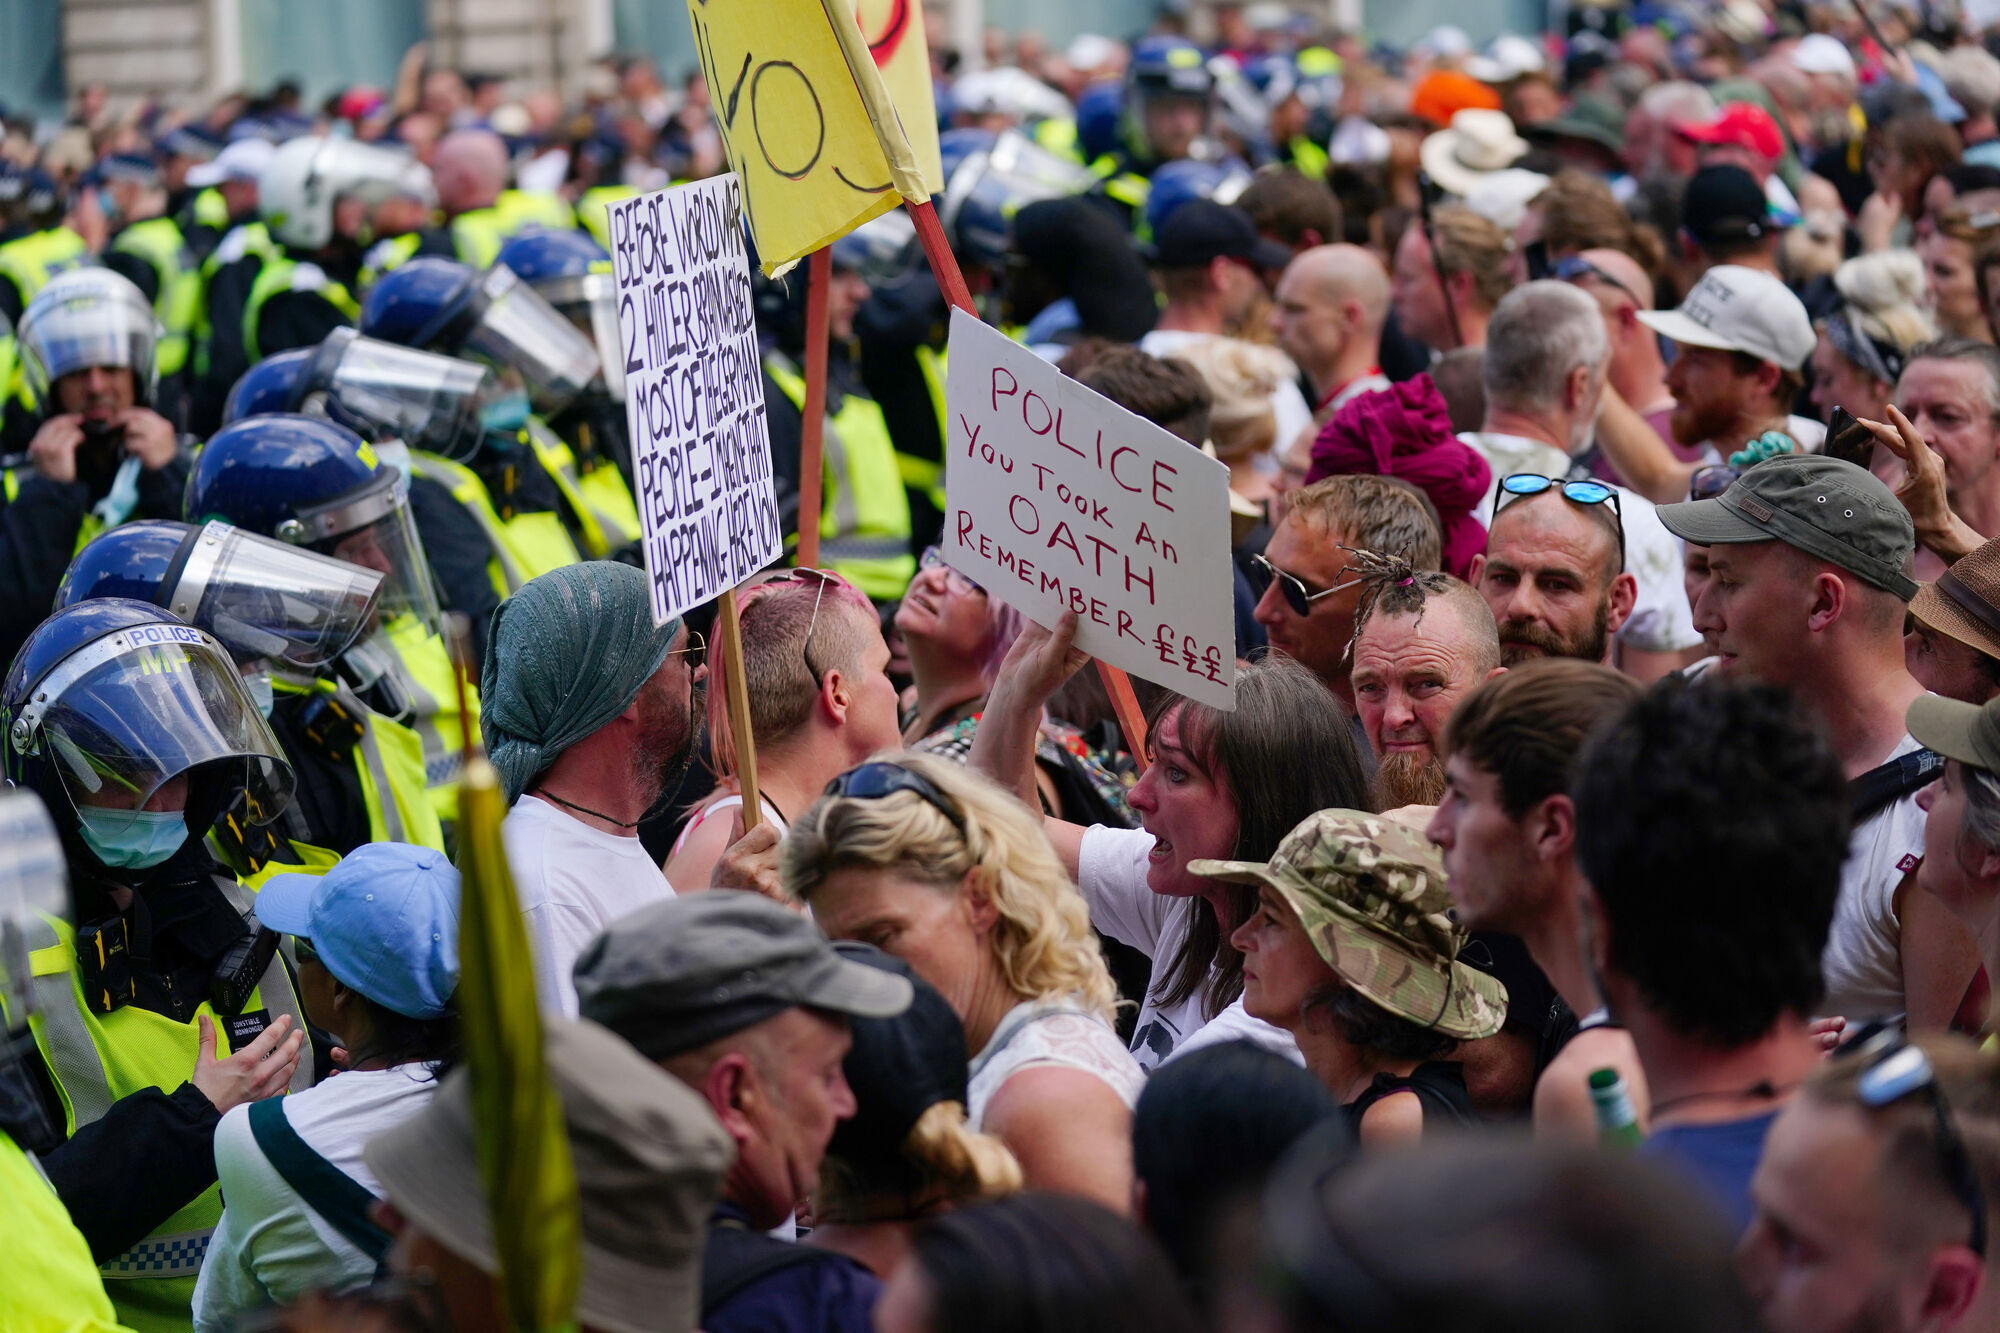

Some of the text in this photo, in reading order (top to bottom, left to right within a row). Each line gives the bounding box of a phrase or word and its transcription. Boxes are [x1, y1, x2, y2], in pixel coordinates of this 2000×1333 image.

[614, 179, 747, 289] BEFORE WORLD WAR
[620, 292, 644, 375] 2
[643, 280, 699, 371] HITLER
[636, 330, 762, 458] MOST OF THE GERMAN
[991, 366, 1179, 513] POLICE
[640, 438, 704, 539] PEOPLE
[741, 403, 770, 483] THAT
[650, 480, 779, 619] HAPPENING HERE NOW
[957, 509, 1229, 687] REMEMBER £££
[1008, 494, 1155, 605] OATH
[129, 626, 201, 646] POLICE
